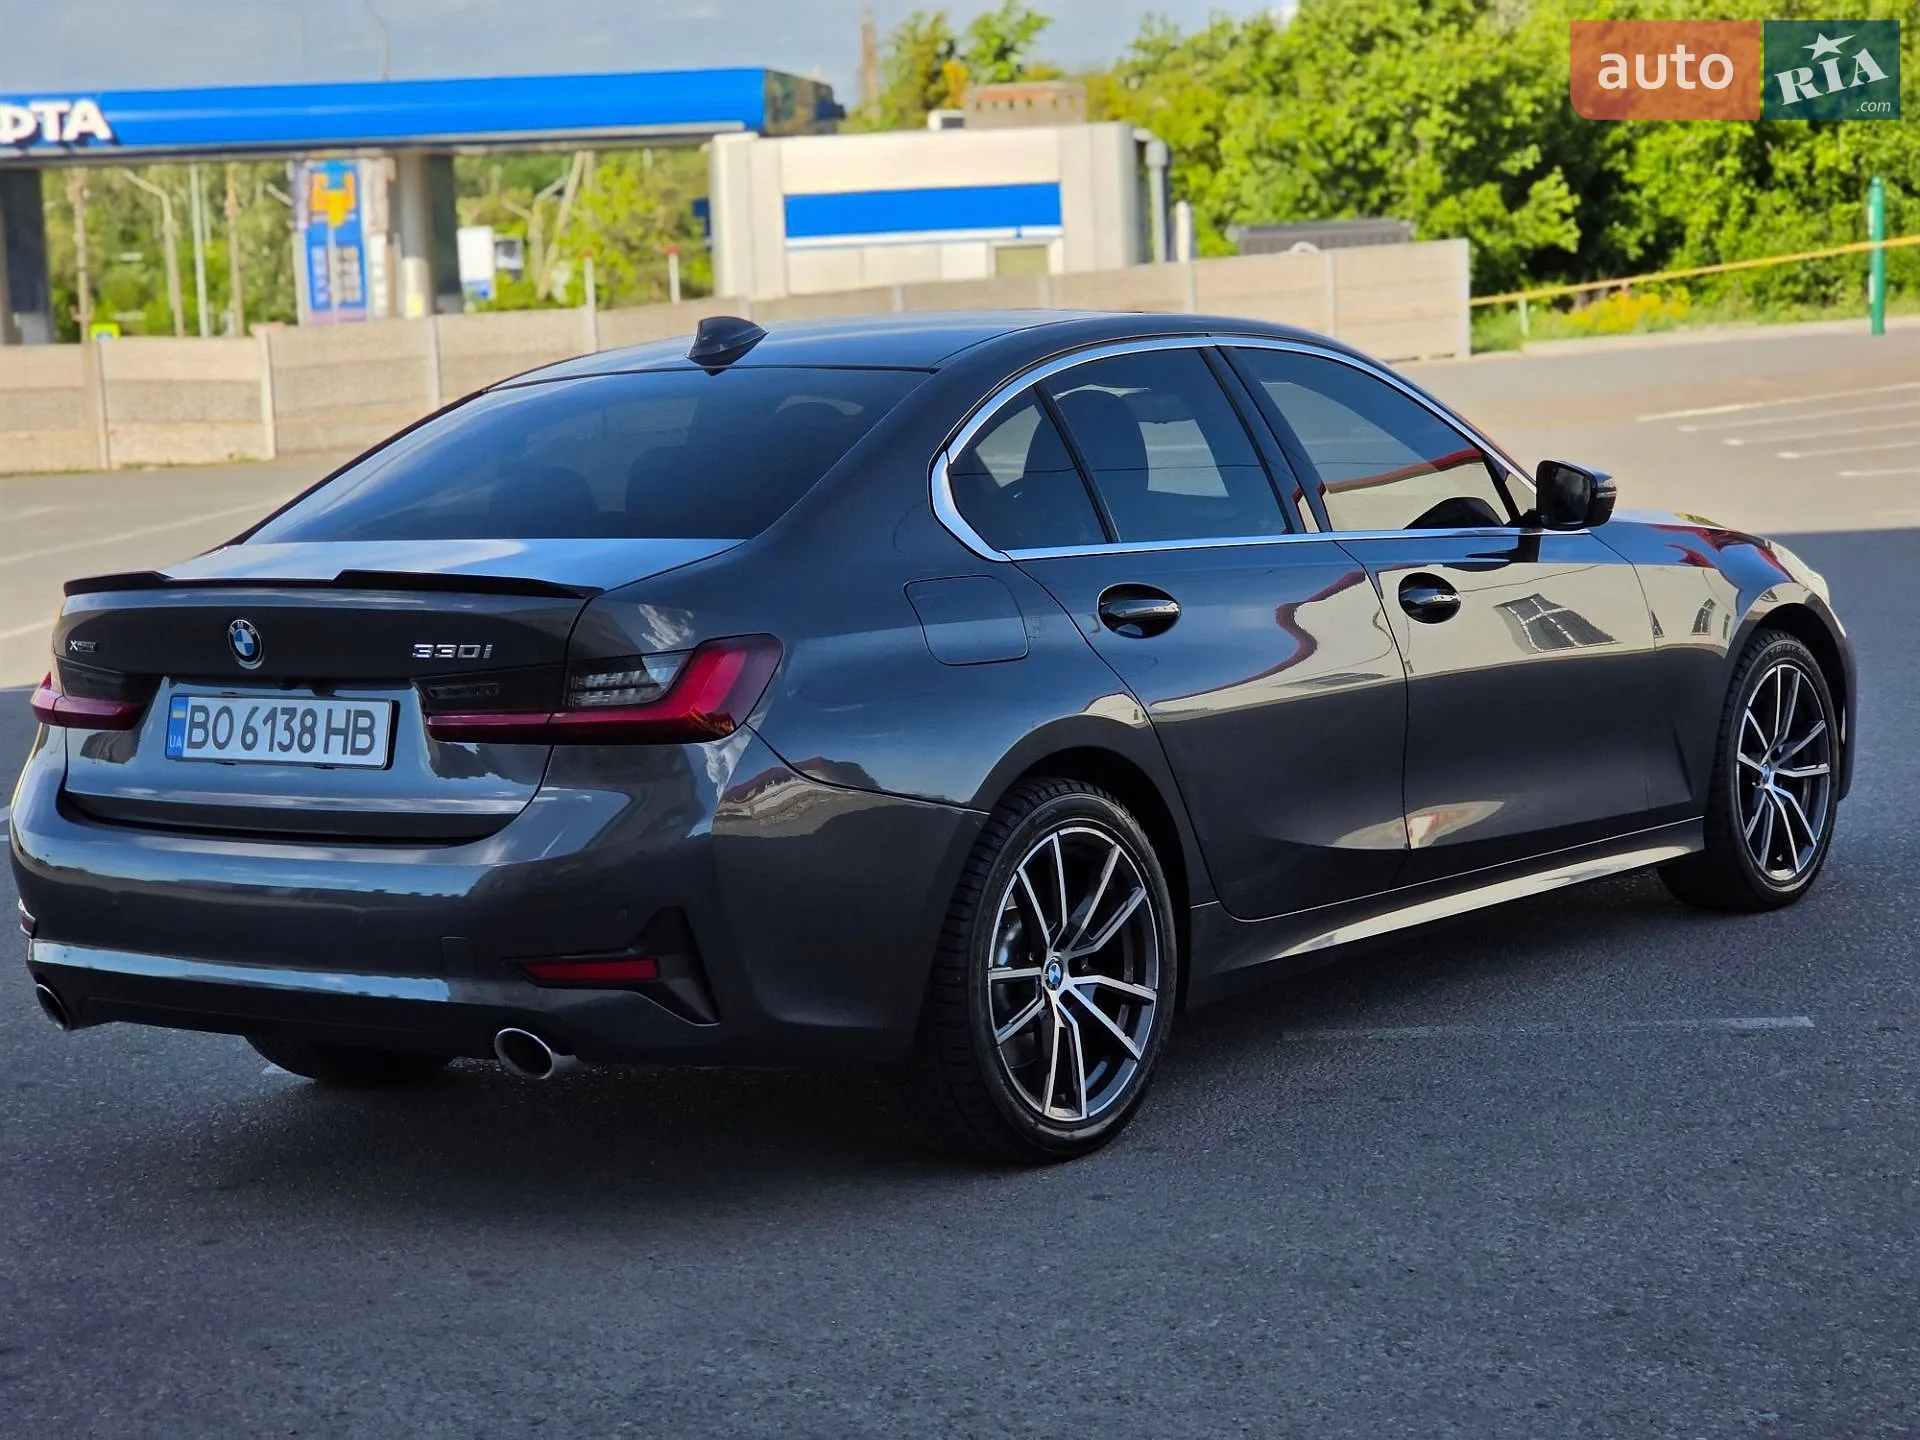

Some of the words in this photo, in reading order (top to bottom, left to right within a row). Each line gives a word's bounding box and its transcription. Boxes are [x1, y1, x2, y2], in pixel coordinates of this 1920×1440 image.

[412, 644, 493, 659] 330i
[186, 705, 234, 750] BO
[240, 706, 318, 753] 6138
[323, 708, 376, 756] HB
[168, 735, 183, 749] UA
